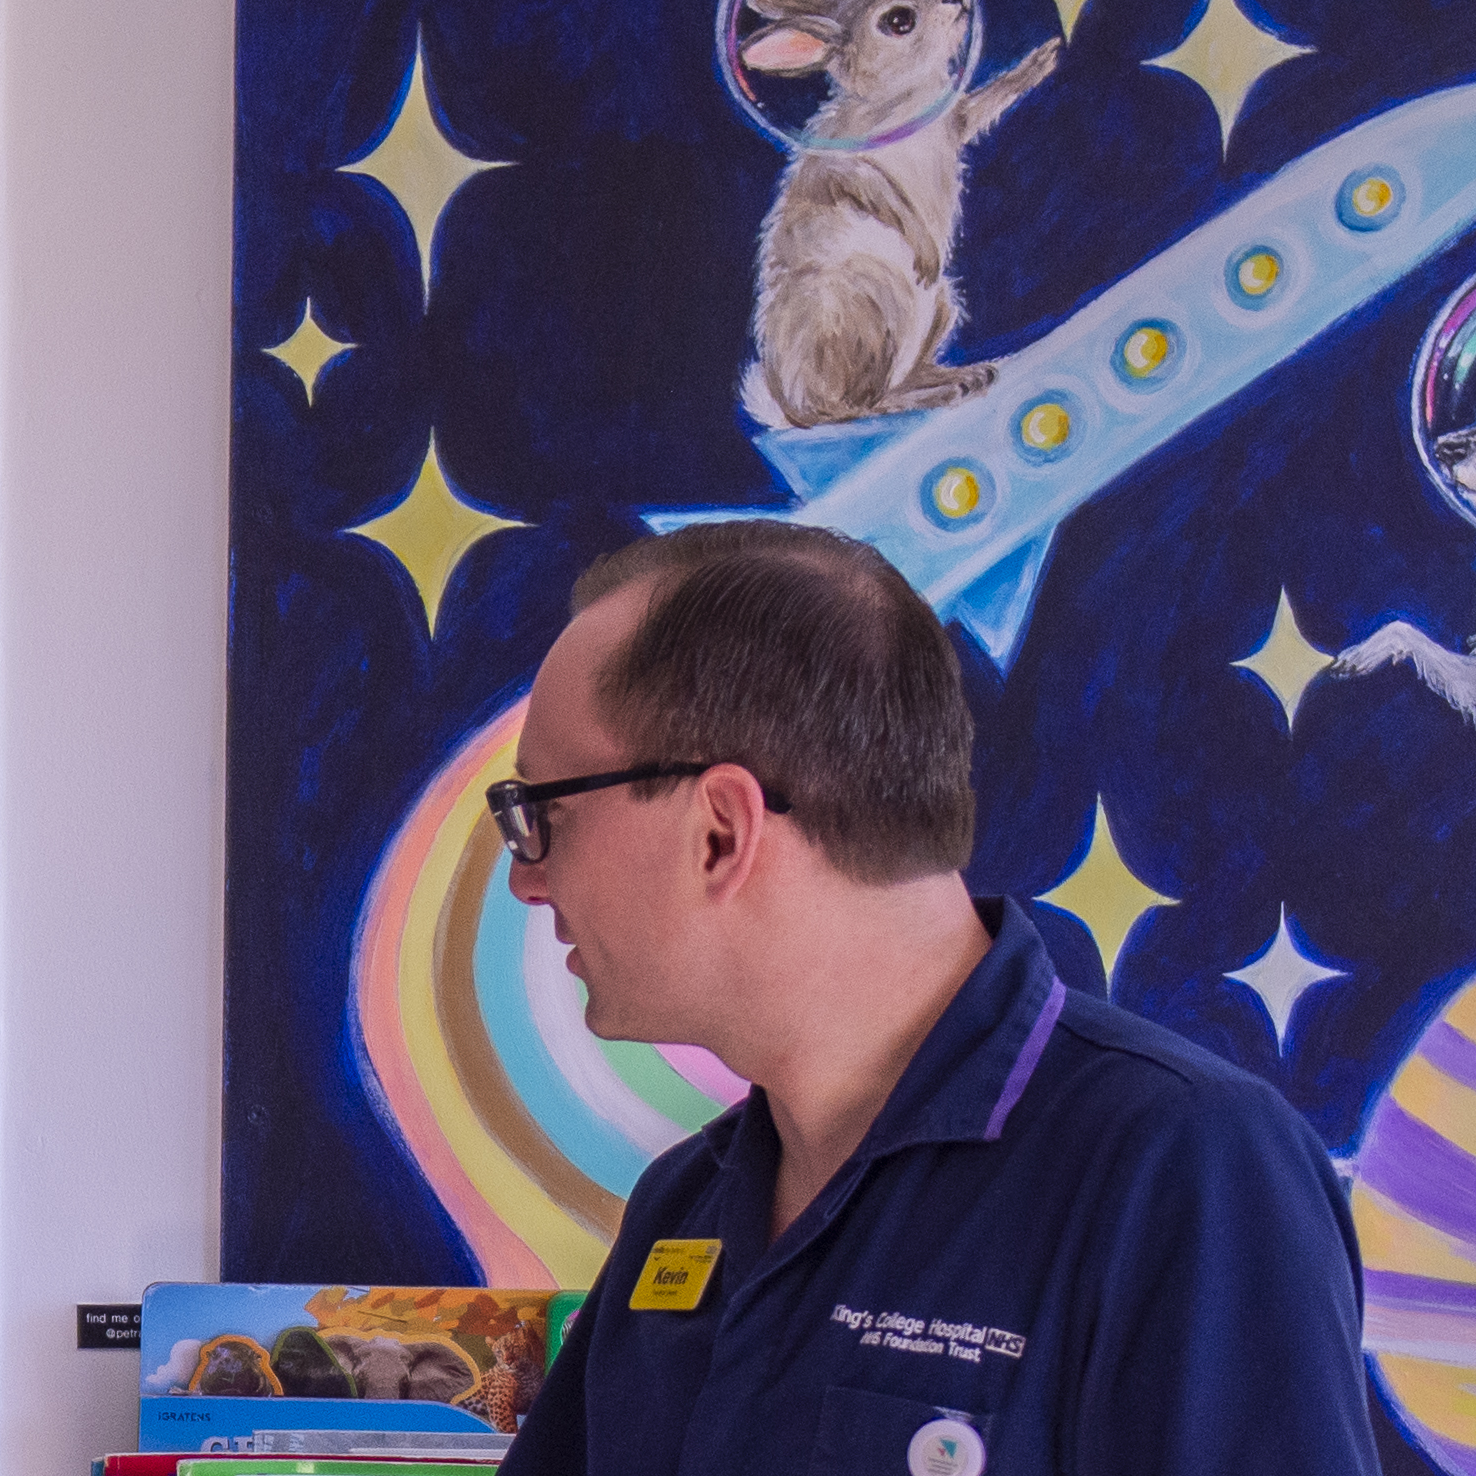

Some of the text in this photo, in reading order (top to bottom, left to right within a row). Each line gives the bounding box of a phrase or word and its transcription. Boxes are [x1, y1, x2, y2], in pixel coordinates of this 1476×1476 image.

[653, 1267, 689, 1285] Kevin
[86, 1313, 107, 1323] find
[111, 1314, 128, 1323] me
[831, 1304, 1026, 1359] King's College Hospital NHS
[883, 1332, 945, 1354] Foundation
[948, 1342, 981, 1363] Trust
